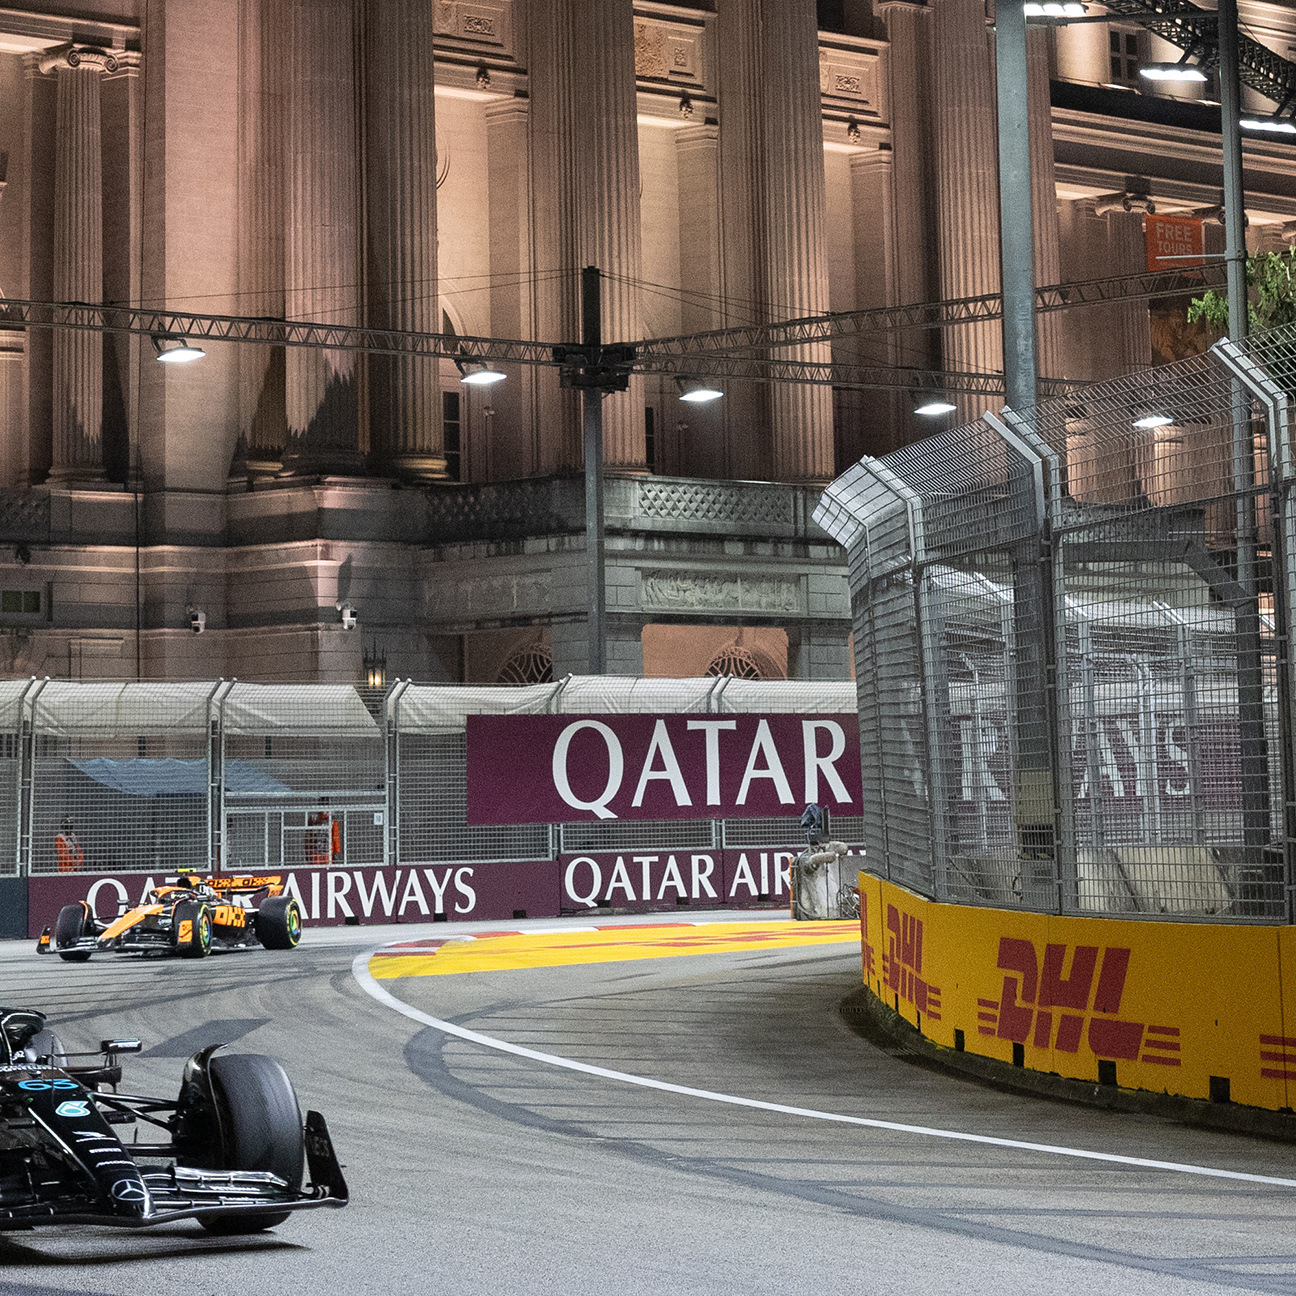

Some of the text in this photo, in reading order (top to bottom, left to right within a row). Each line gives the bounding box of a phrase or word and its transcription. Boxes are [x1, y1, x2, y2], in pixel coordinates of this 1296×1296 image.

[1156, 222, 1192, 242] FREE
[1157, 240, 1193, 255] TOURS
[552, 718, 854, 819] QATAR
[282, 866, 477, 920] AIRWAYS
[565, 854, 719, 907] QATAR
[887, 903, 928, 1014] DHL
[996, 936, 1146, 1061] DHL
[18, 1078, 79, 1091] 63
